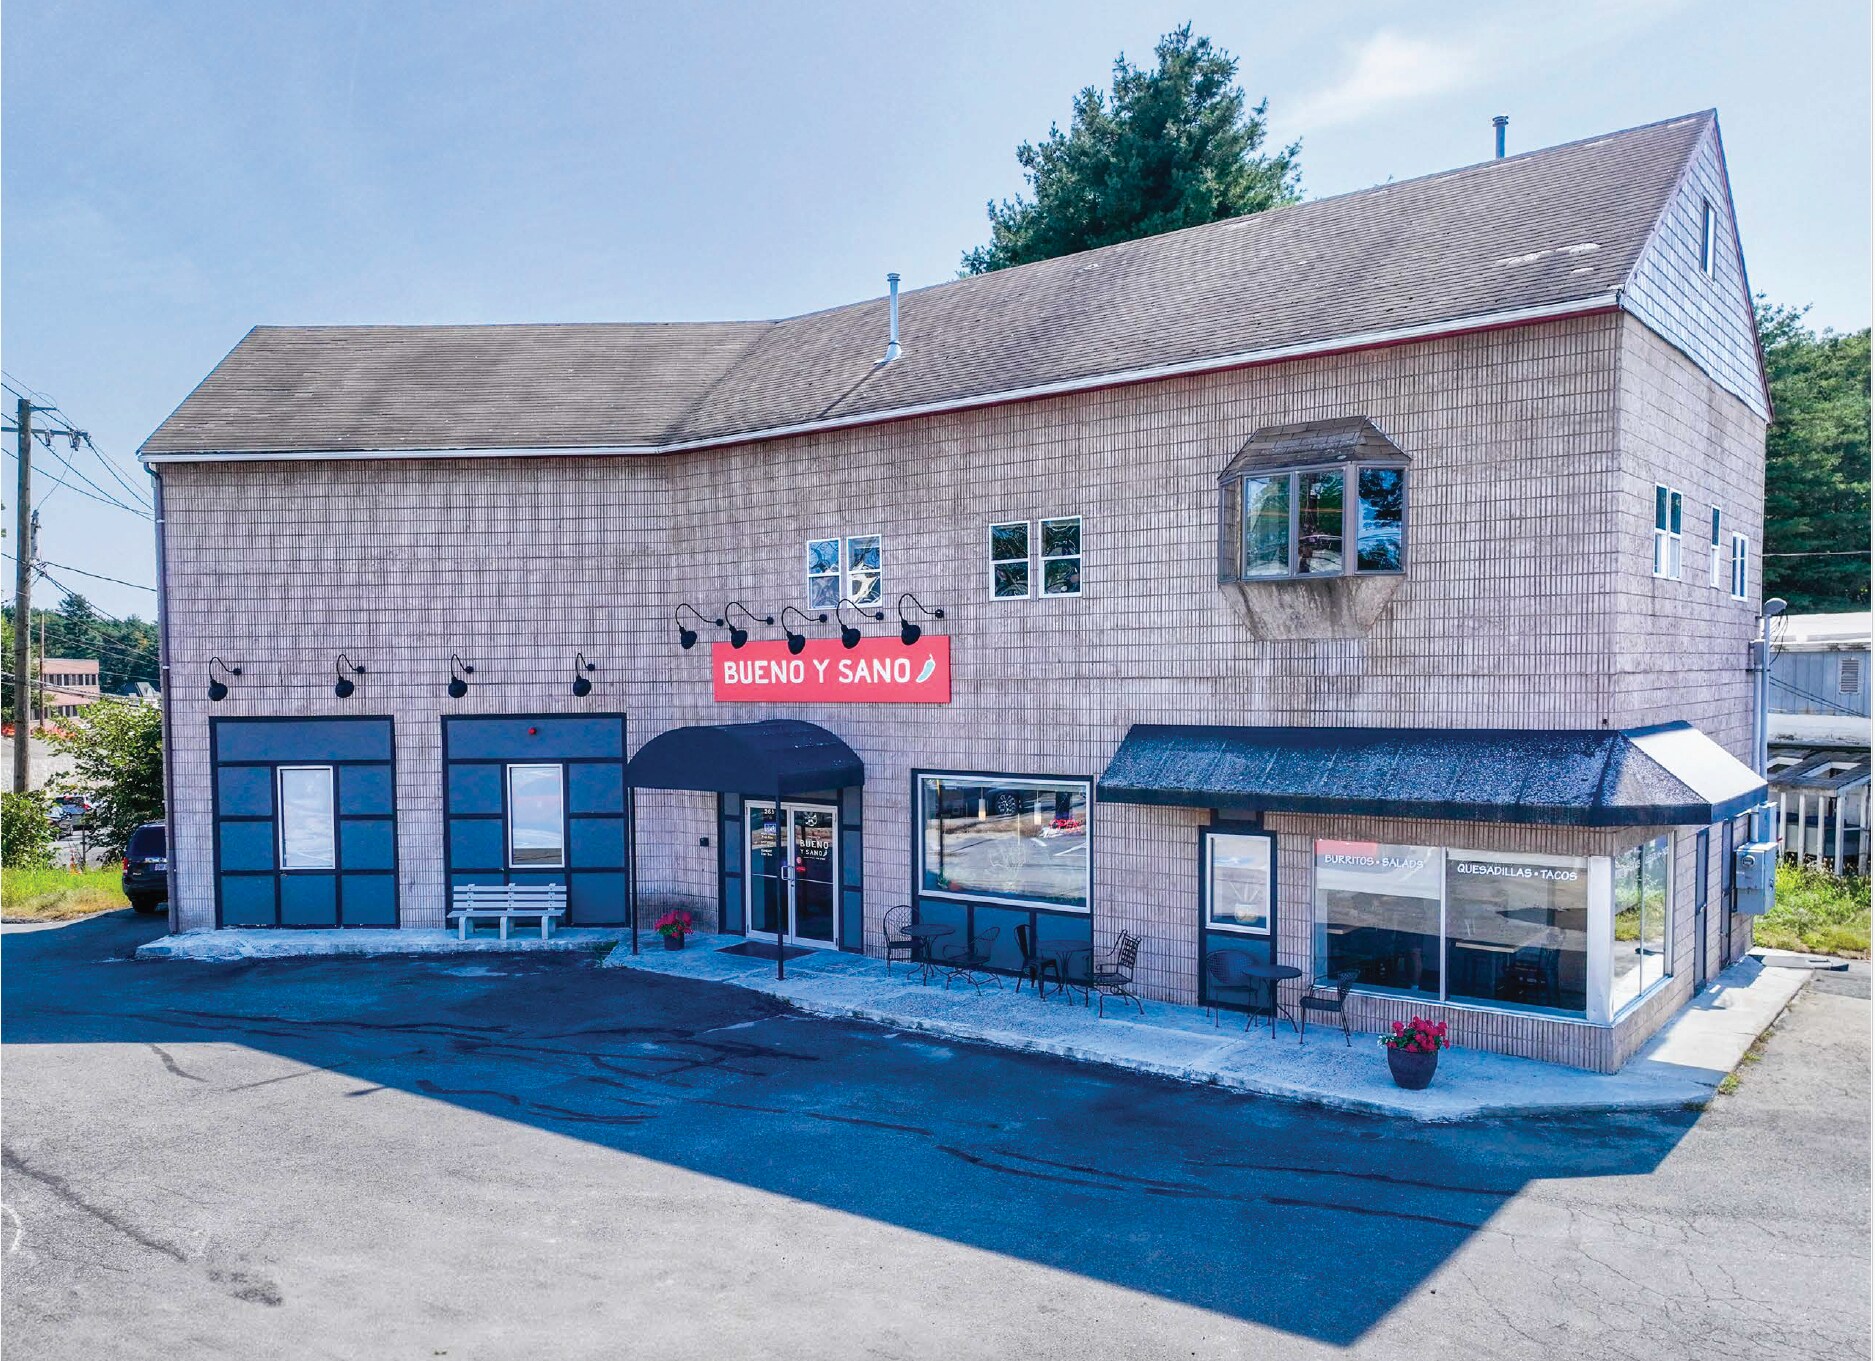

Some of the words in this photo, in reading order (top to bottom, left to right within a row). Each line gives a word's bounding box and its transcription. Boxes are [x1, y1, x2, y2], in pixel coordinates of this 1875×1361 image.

[723, 659, 805, 685] BUENO
[813, 659, 830, 684] Y
[838, 658, 911, 685] SANO
[799, 839, 829, 850] BUENO
[1324, 854, 1375, 867] BURRITOS
[1382, 857, 1425, 870] SALADS
[1457, 863, 1533, 879] QUESADILLAS
[1540, 868, 1579, 882] TACOS
